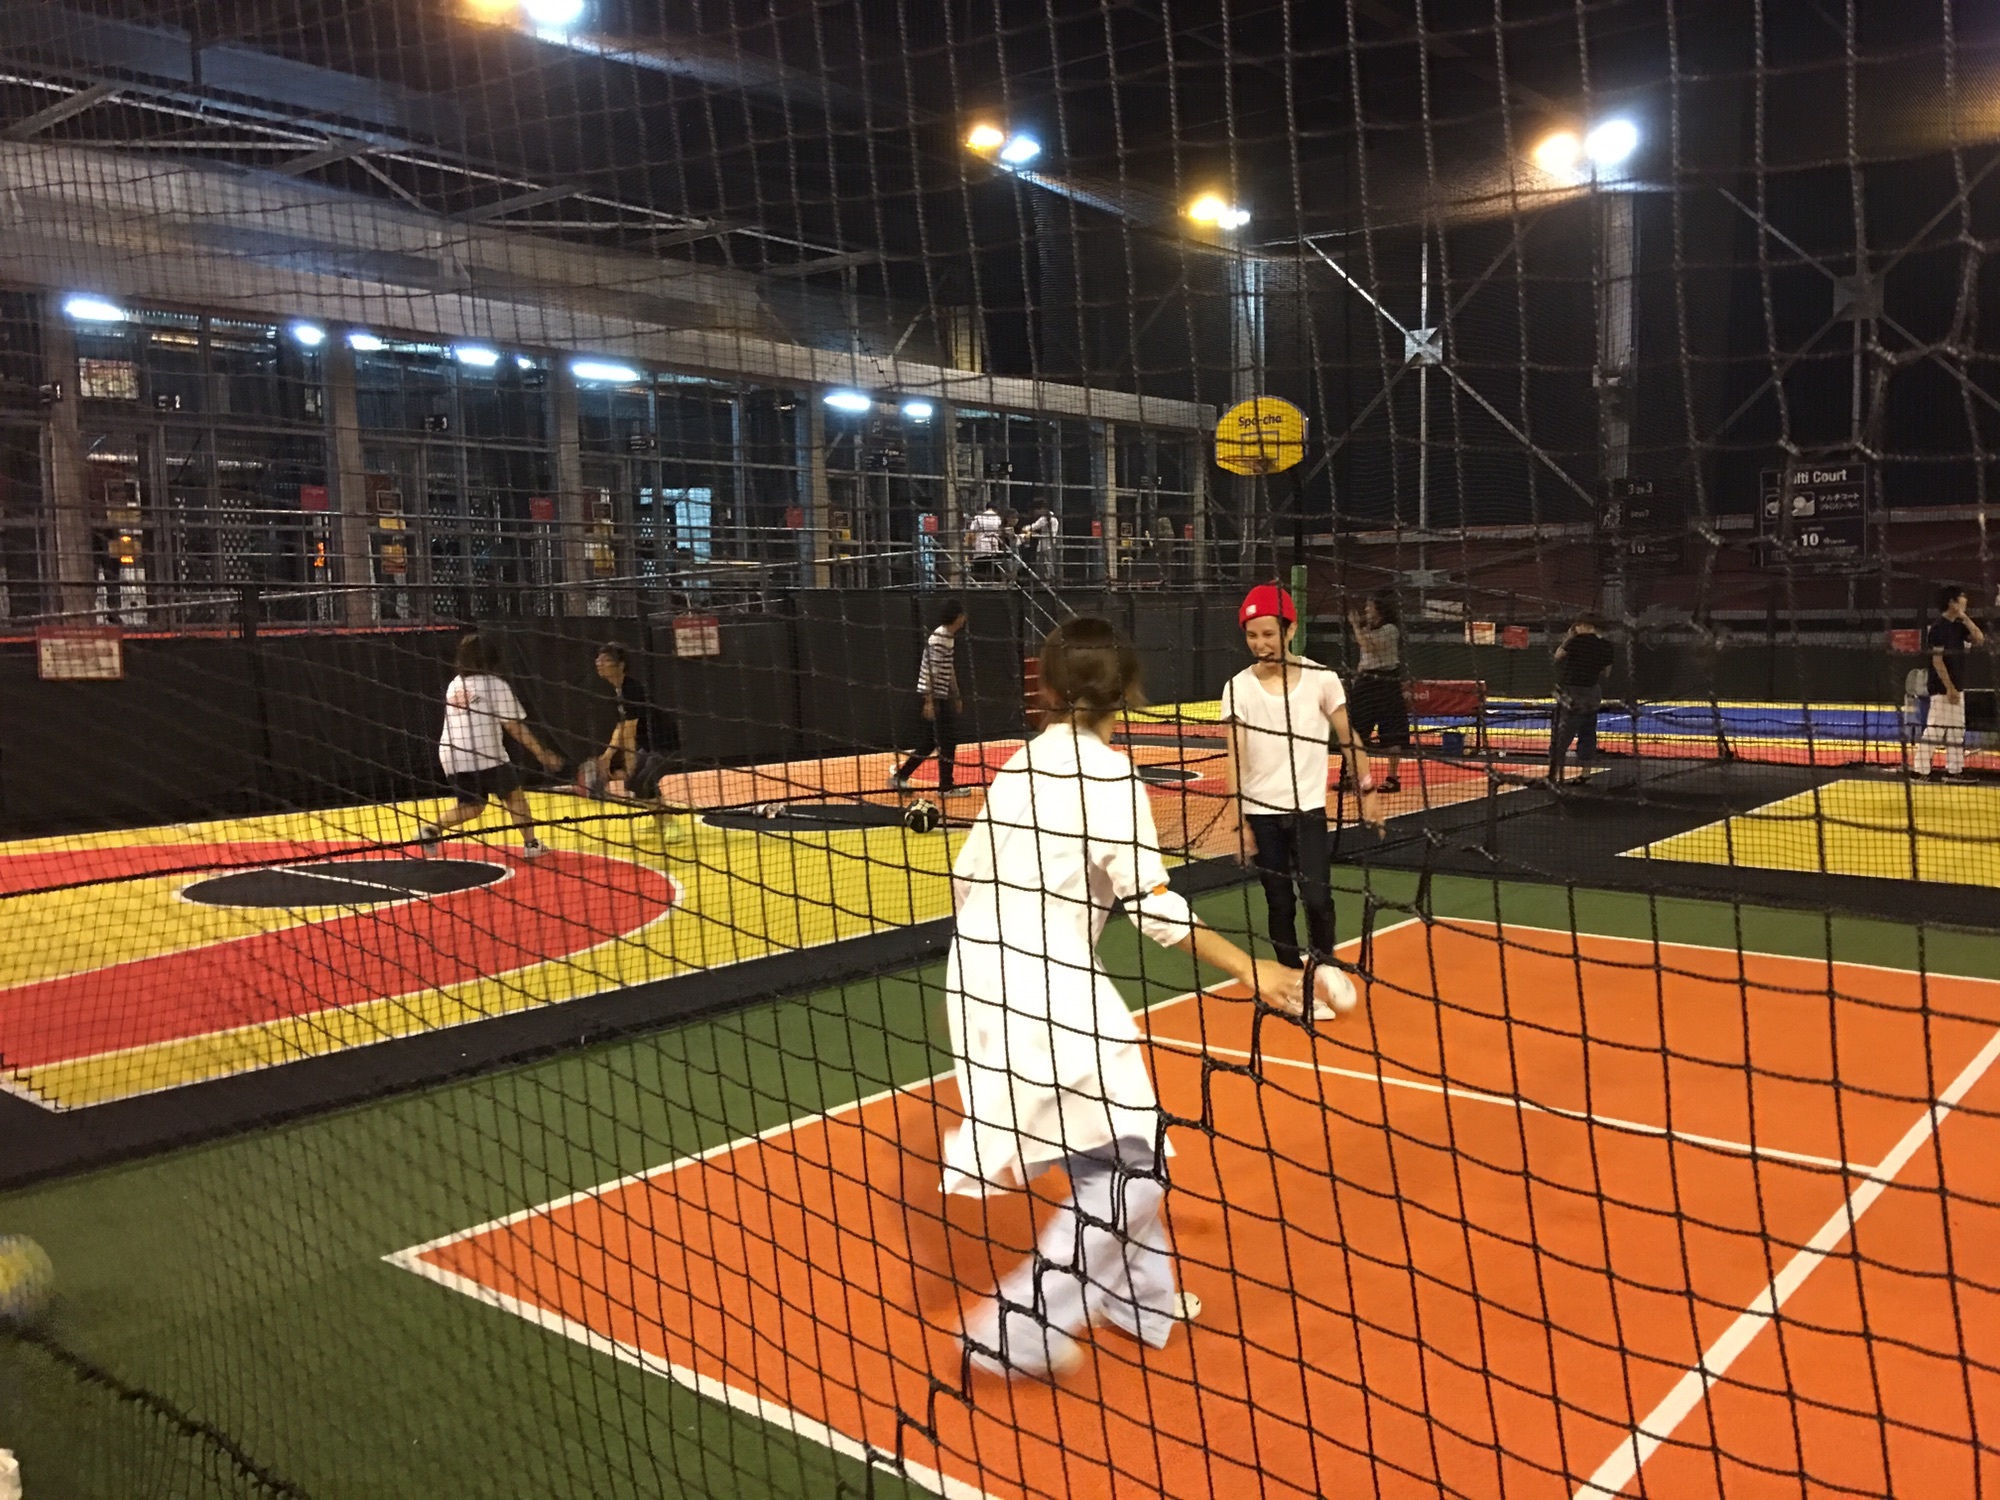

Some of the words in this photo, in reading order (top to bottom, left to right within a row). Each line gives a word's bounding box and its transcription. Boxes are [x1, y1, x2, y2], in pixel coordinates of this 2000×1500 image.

[1238, 414, 1282, 429] Spo-cha
[1777, 472, 1809, 485] lti
[1813, 469, 1847, 484] Court
[1801, 532, 1819, 547] 10
